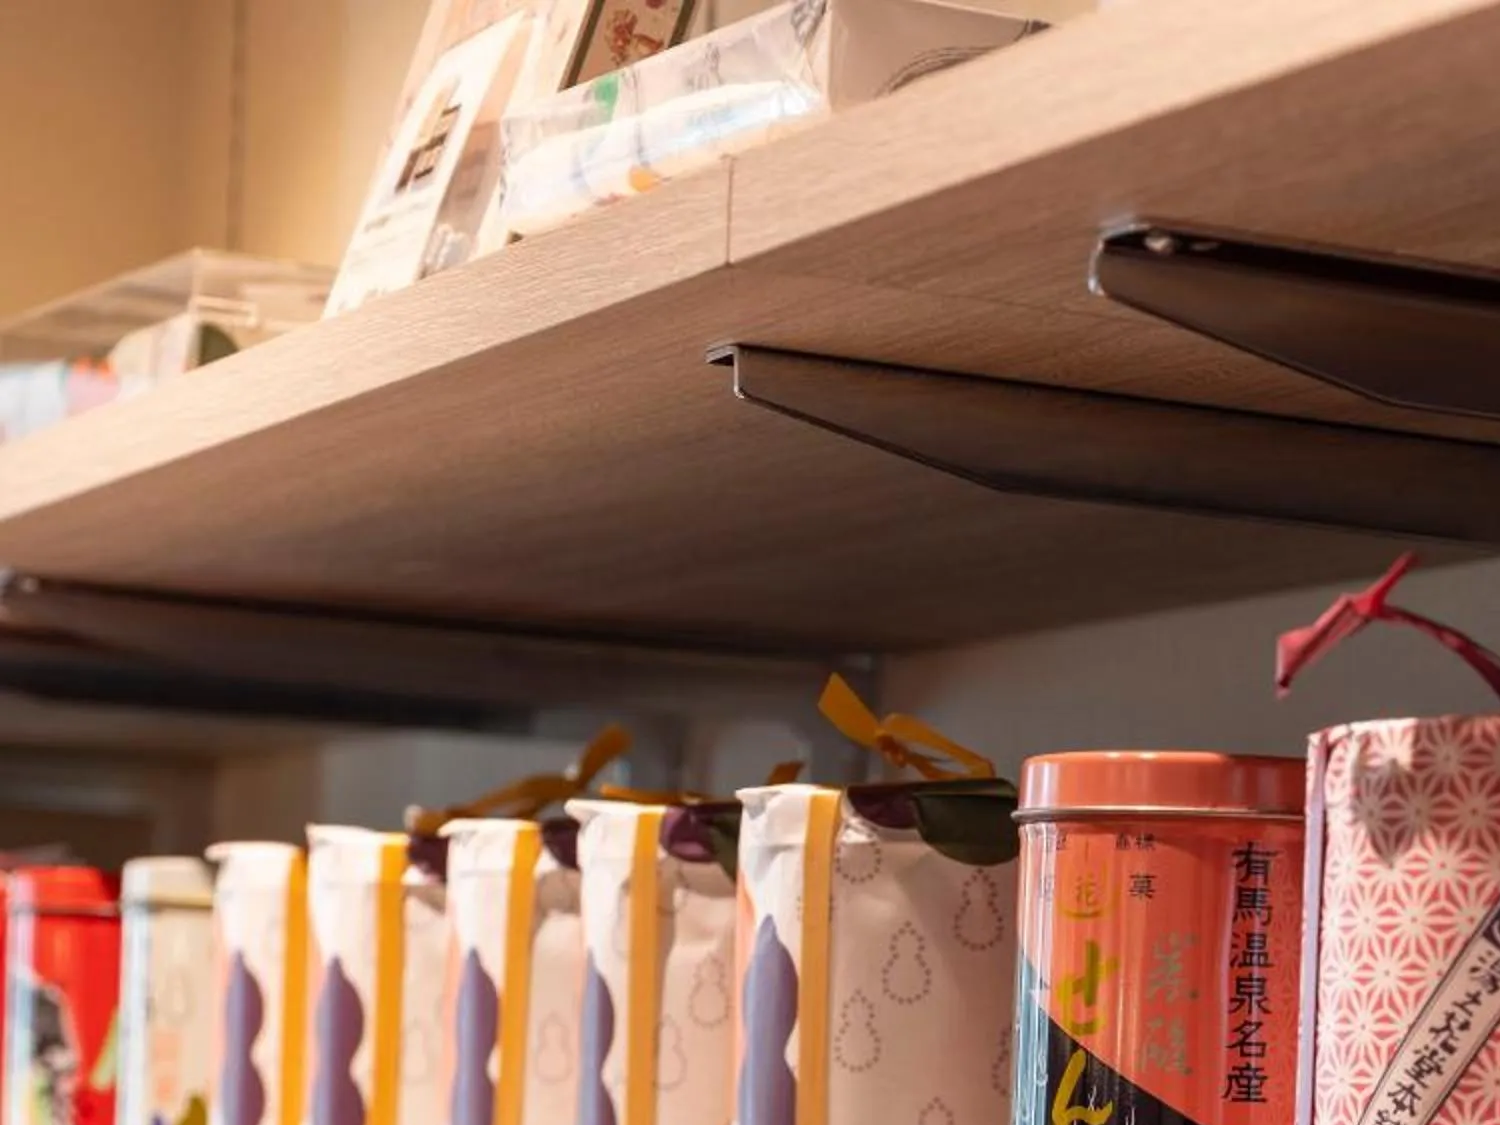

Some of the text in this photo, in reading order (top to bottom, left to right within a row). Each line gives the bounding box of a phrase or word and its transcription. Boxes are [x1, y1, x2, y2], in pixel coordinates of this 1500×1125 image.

[1223, 841, 1279, 1103] 有馬温泉名産
